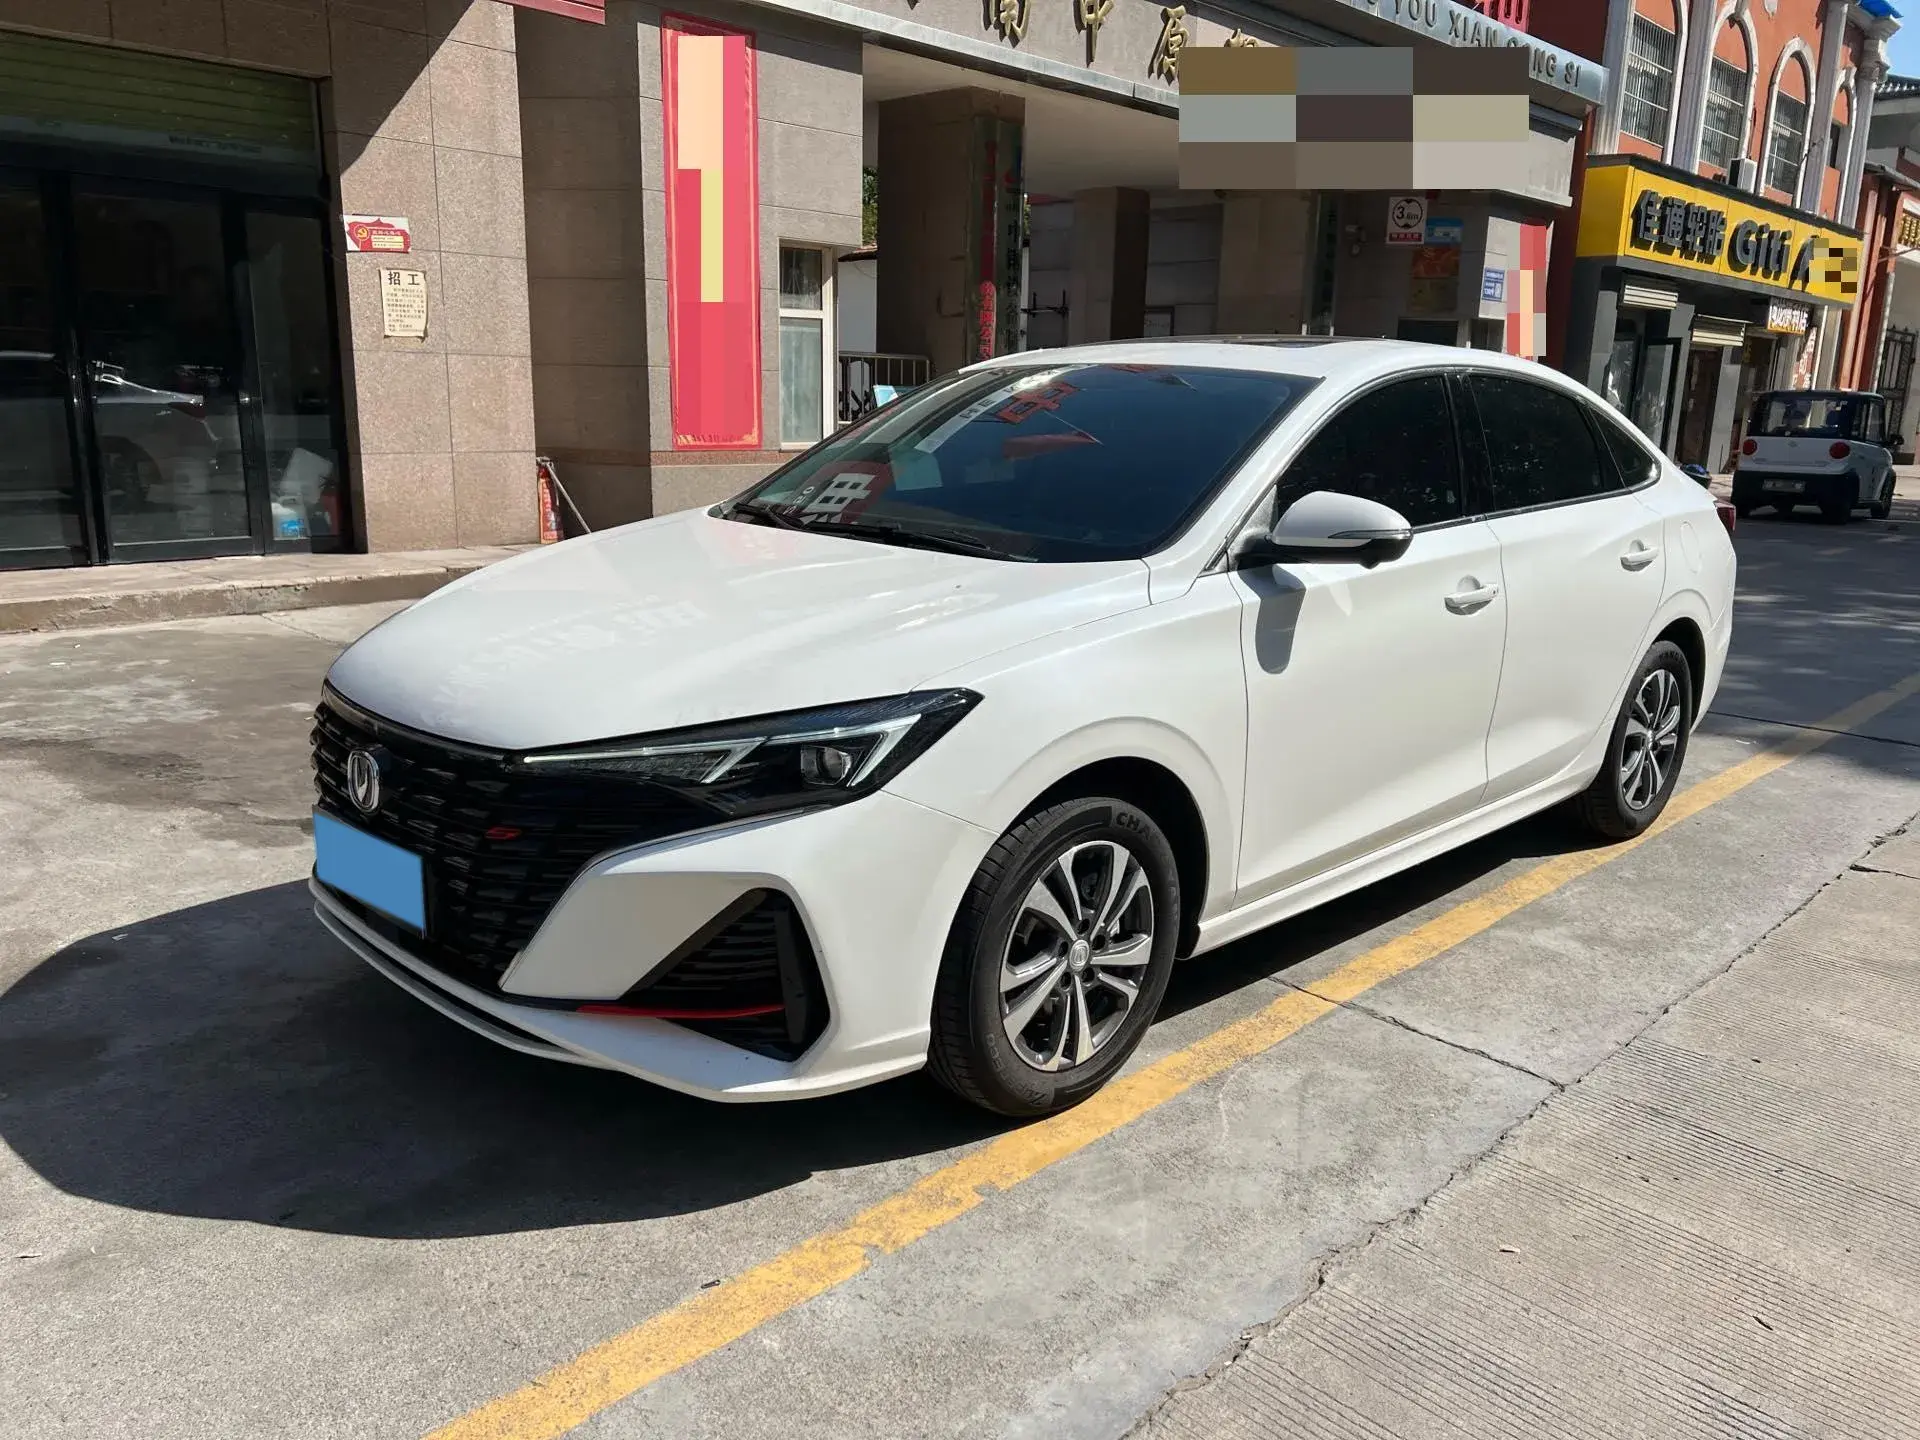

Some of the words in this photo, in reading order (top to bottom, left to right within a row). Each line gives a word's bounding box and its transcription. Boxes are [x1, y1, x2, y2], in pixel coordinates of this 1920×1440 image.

[1564, 60, 1581, 88] SI
[1634, 190, 1725, 260] 佳通轮胎
[1732, 218, 1792, 275] Giti
[388, 271, 421, 286] 招工
